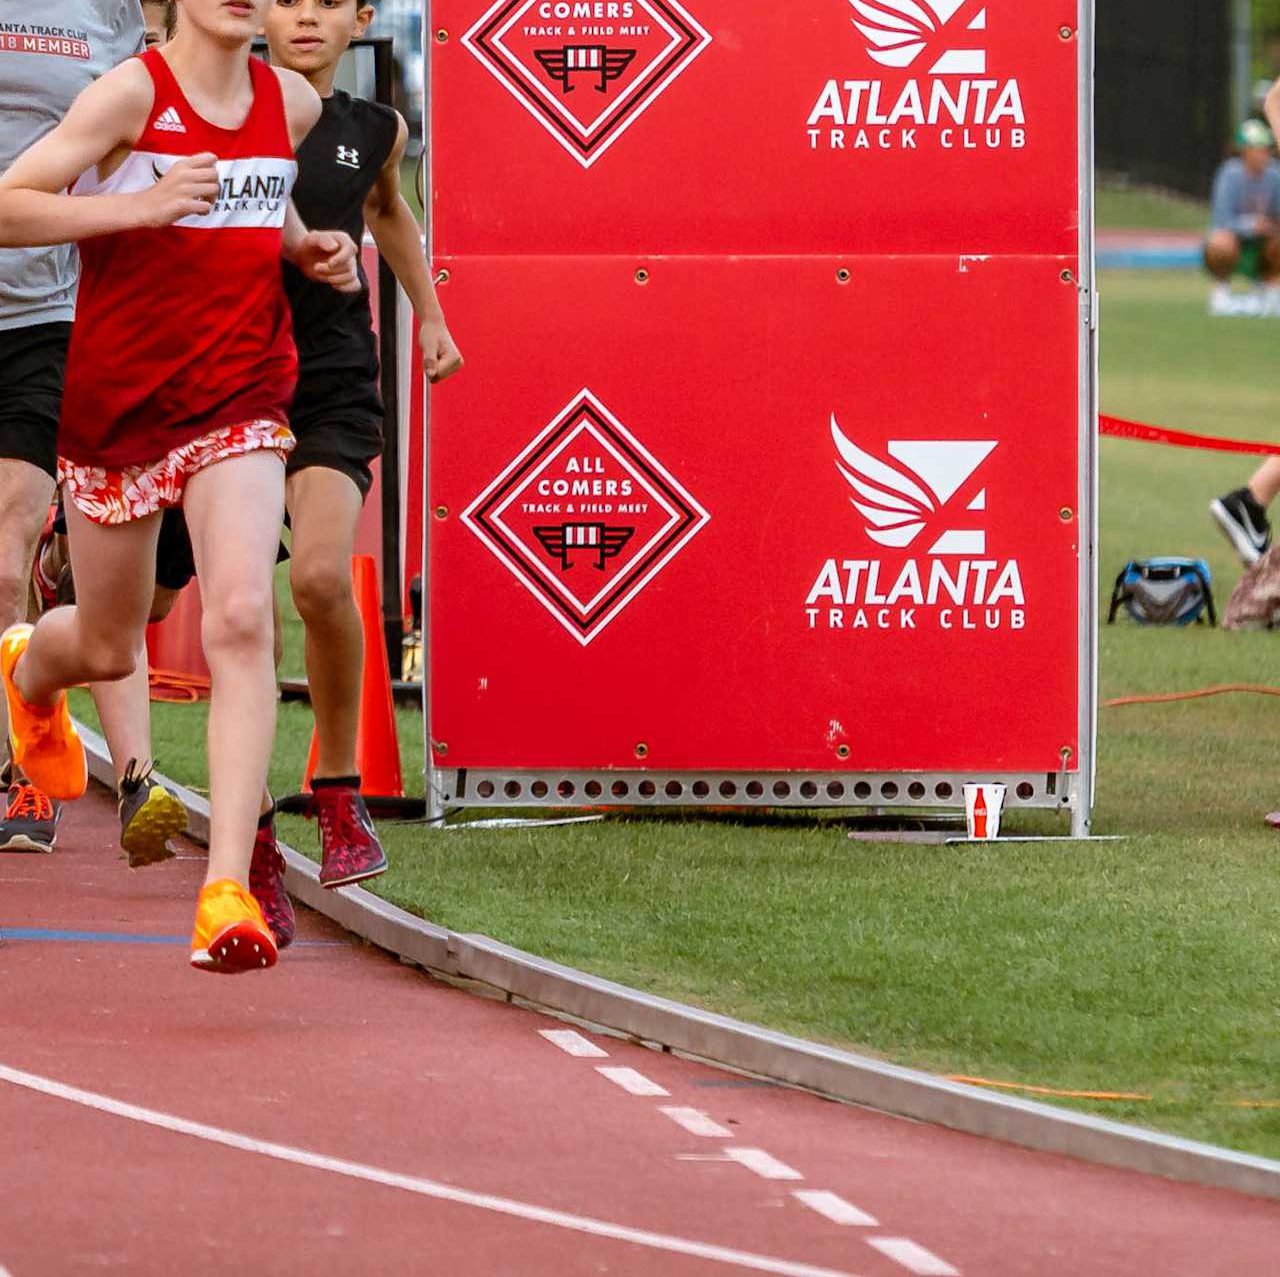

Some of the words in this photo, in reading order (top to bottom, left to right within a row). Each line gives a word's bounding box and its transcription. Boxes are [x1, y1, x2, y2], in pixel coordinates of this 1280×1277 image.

[539, 2, 634, 19] COMERS
[30, 25, 66, 38] TRACK
[66, 28, 88, 42] CLUB
[523, 26, 562, 36] TRACK
[567, 26, 576, 36] &
[582, 26, 614, 36] FIELD
[619, 26, 649, 36] MEET
[23, 36, 90, 58] MEMBER
[806, 78, 1026, 125] ATLANTA
[807, 128, 917, 149] TRACK
[940, 128, 1026, 149] CLUB
[217, 175, 285, 200] TLANTA
[214, 200, 248, 211] RACK
[566, 457, 605, 473] ALL
[538, 479, 633, 496] COMERS
[522, 503, 561, 513] TRACK
[566, 503, 575, 513] &
[581, 503, 613, 513] FIELD
[618, 503, 648, 513] MEET
[805, 558, 1025, 605] ATLANTA
[805, 608, 916, 629] TRACK
[940, 608, 1025, 629] CLUB
